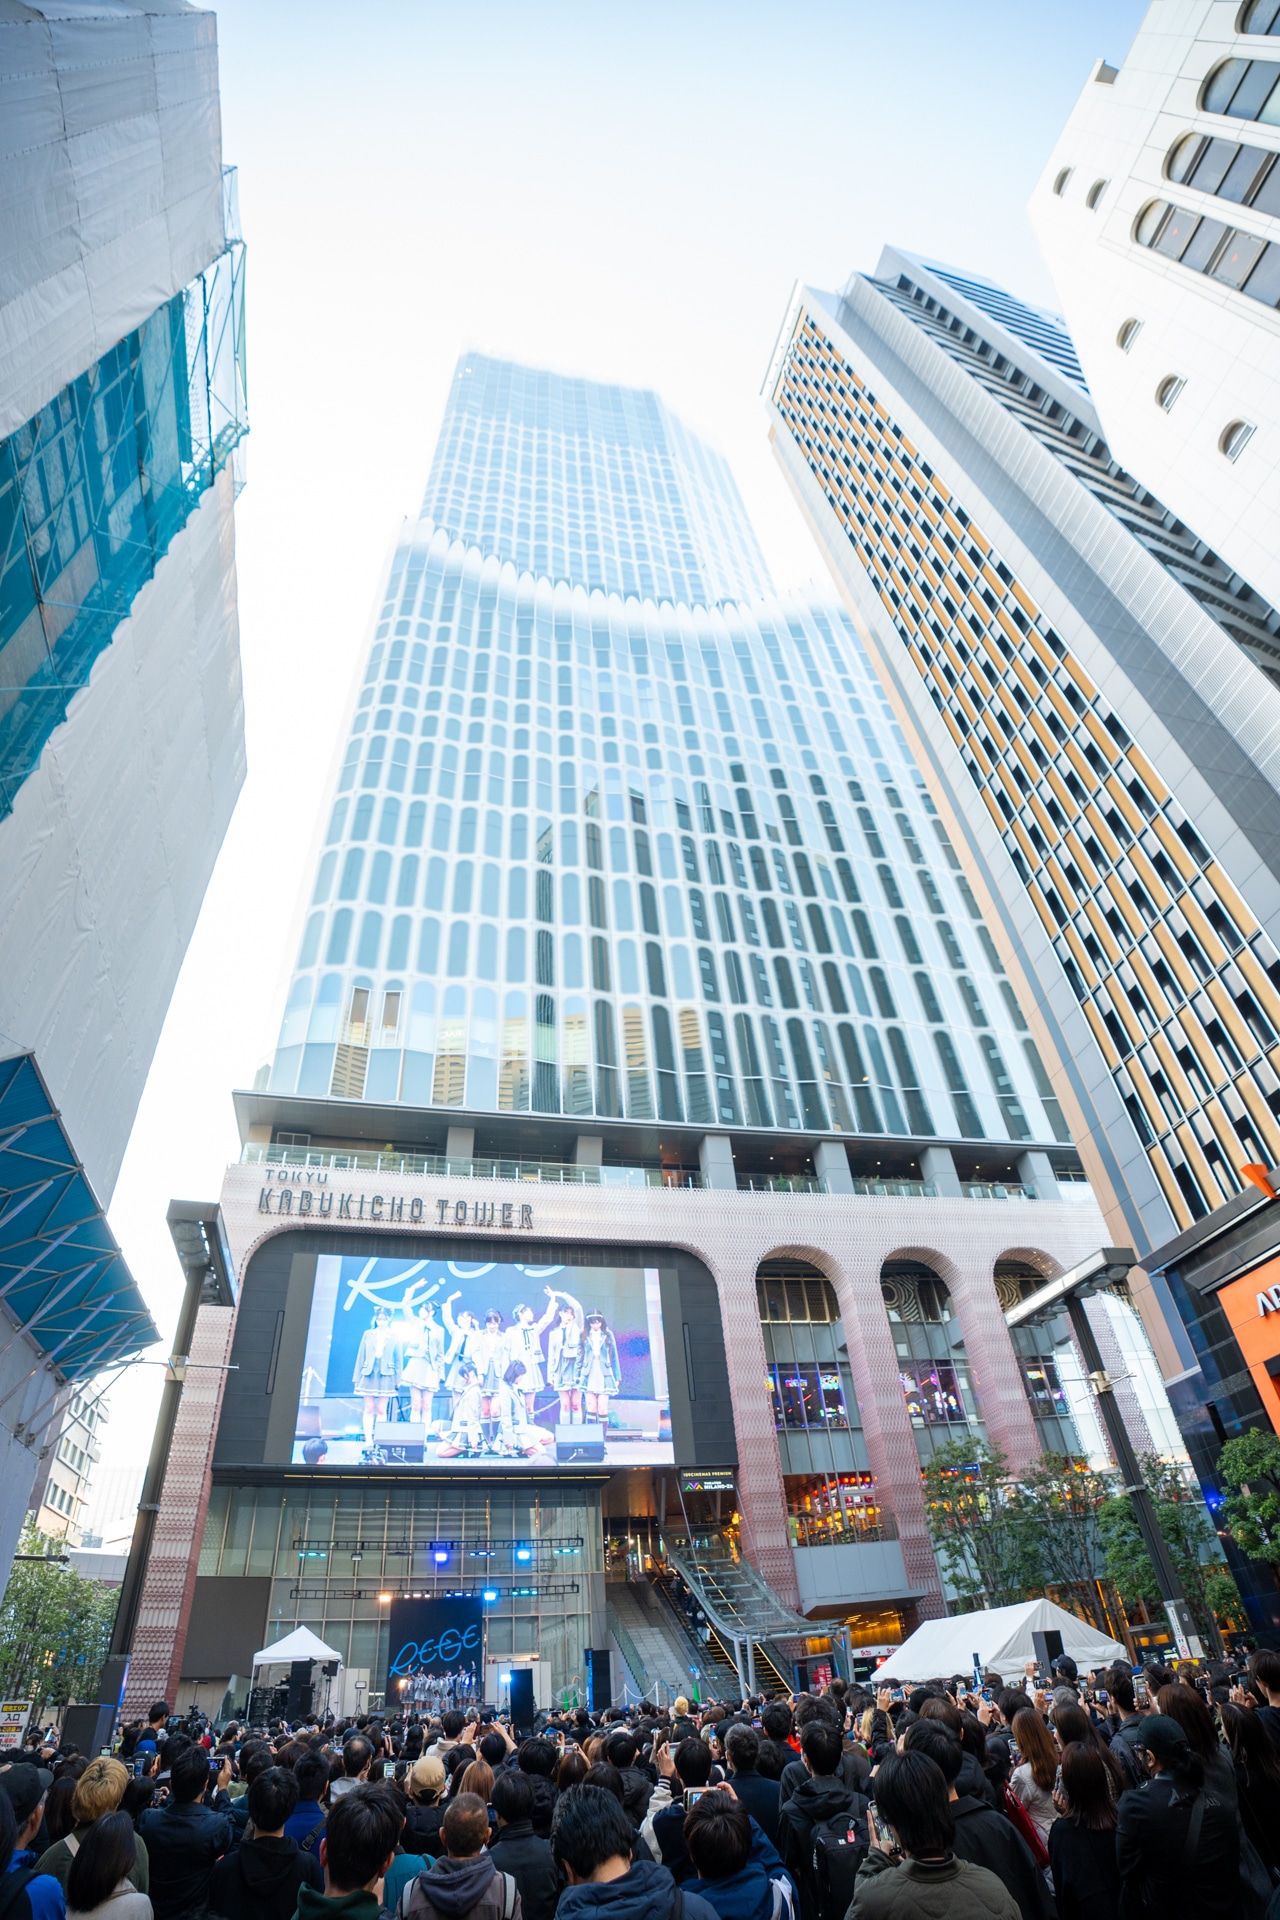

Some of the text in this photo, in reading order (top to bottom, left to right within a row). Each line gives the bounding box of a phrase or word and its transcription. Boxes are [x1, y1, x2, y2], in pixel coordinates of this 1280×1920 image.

[265, 1169, 328, 1184] TOKYU
[258, 1187, 533, 1228] KABUKICHO TOWER
[5, 1713, 21, 1721] 入口
